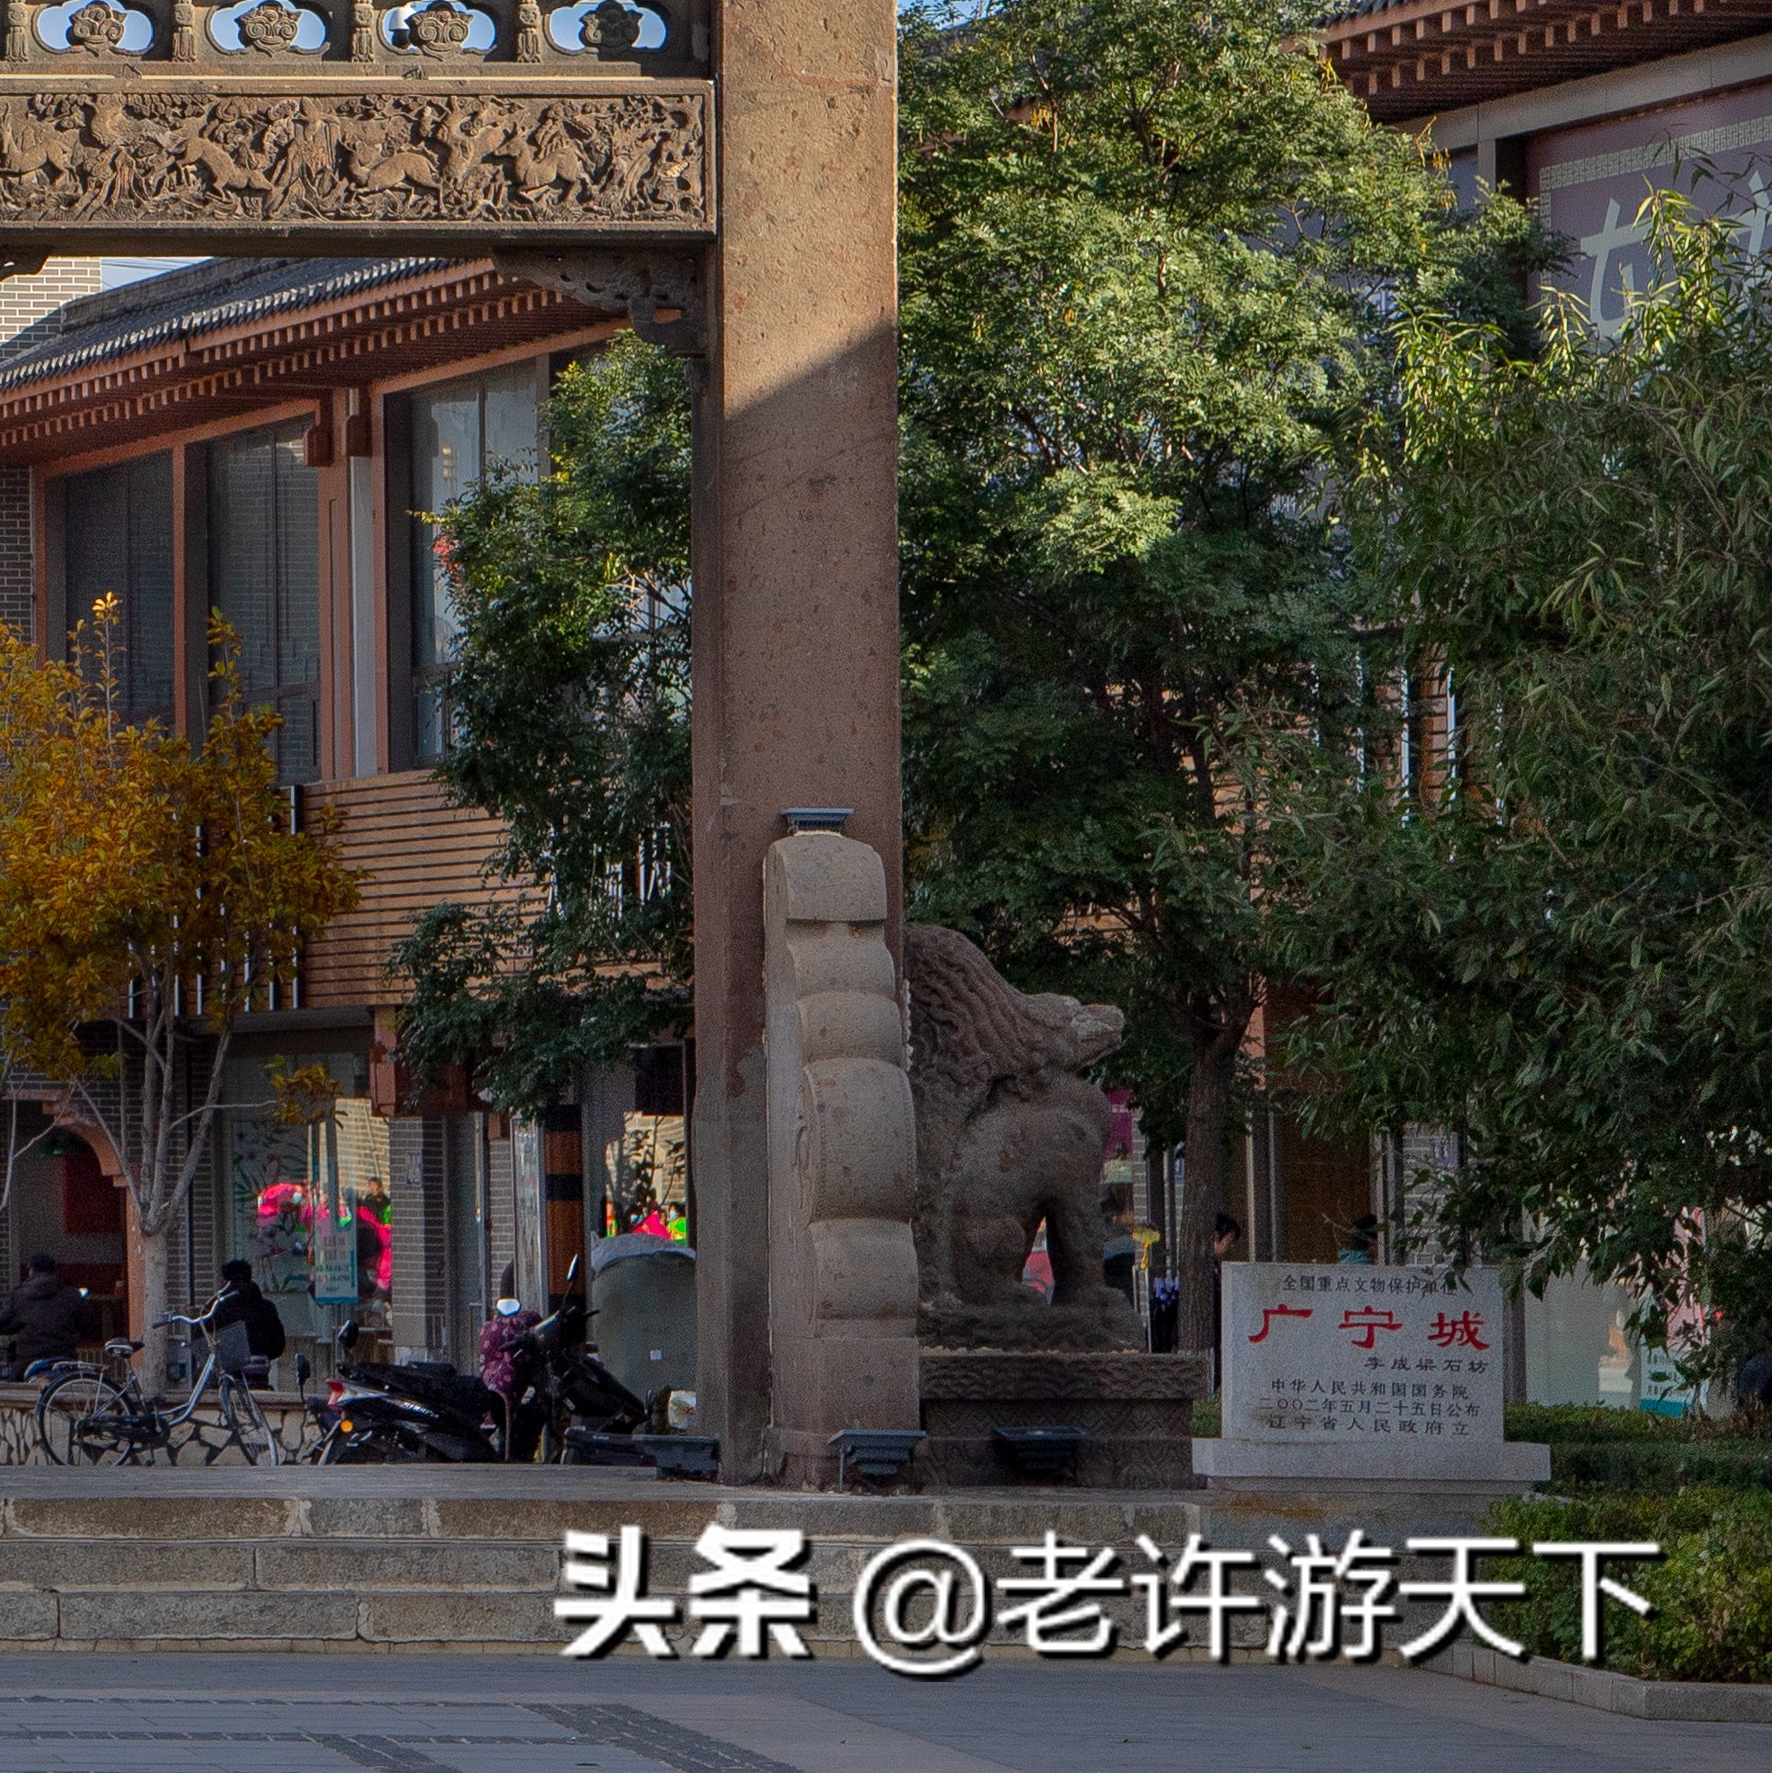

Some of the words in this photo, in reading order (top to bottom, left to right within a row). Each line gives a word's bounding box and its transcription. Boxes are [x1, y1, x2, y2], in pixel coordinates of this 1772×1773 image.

[1248, 1303, 1490, 1351] 广宁城
[1363, 1356, 1490, 1374] 李成梁石坊
[1271, 1378, 1470, 1400] 中华人民共和国国务院
[1266, 1415, 1471, 1437] 辽宁省人民政府立
